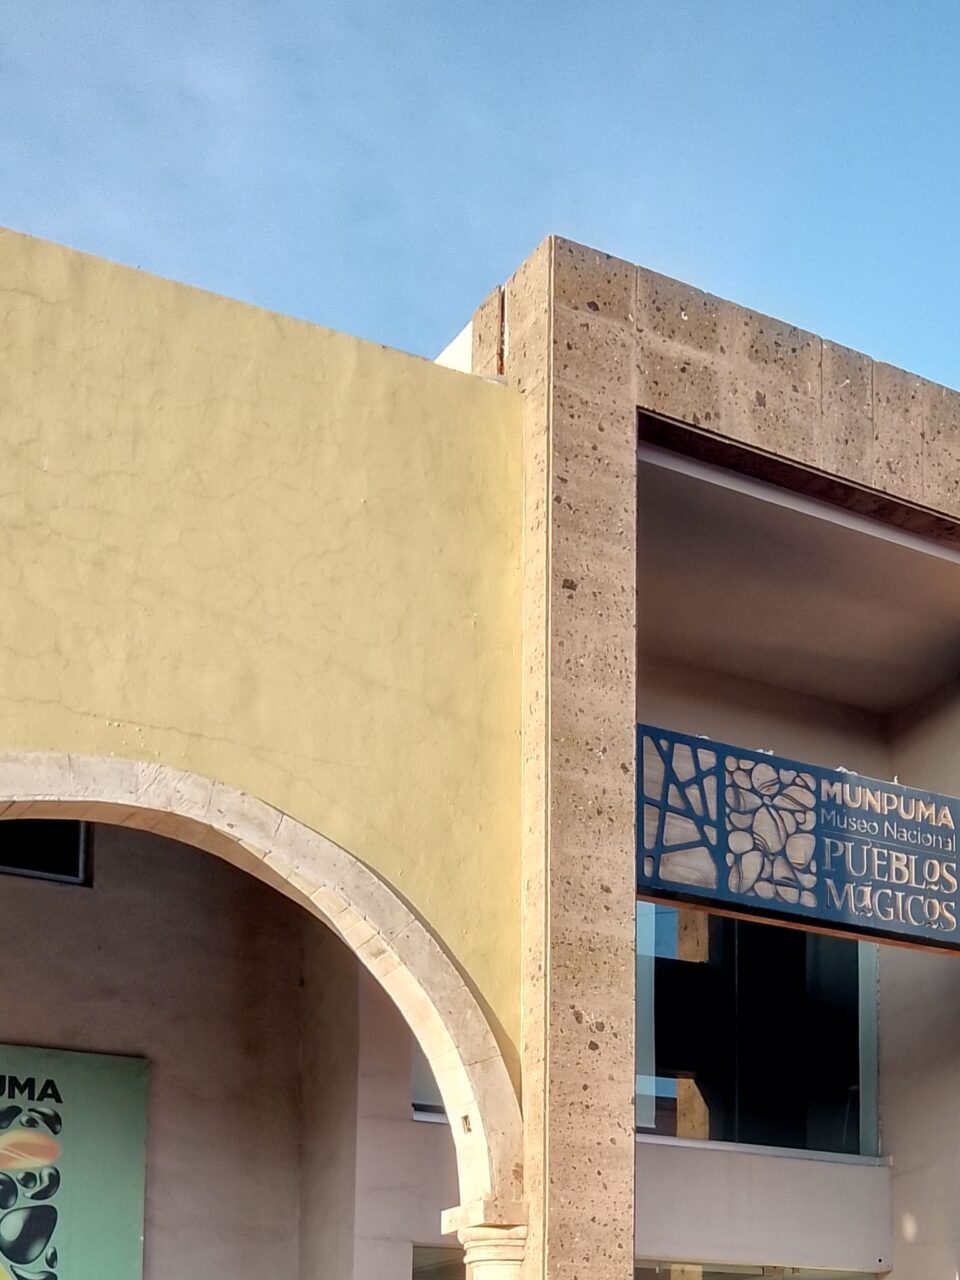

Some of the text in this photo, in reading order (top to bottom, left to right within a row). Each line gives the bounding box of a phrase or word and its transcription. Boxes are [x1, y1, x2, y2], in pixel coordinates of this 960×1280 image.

[820, 778, 955, 830] MUNPUMA
[820, 807, 956, 852] Museo Nacional
